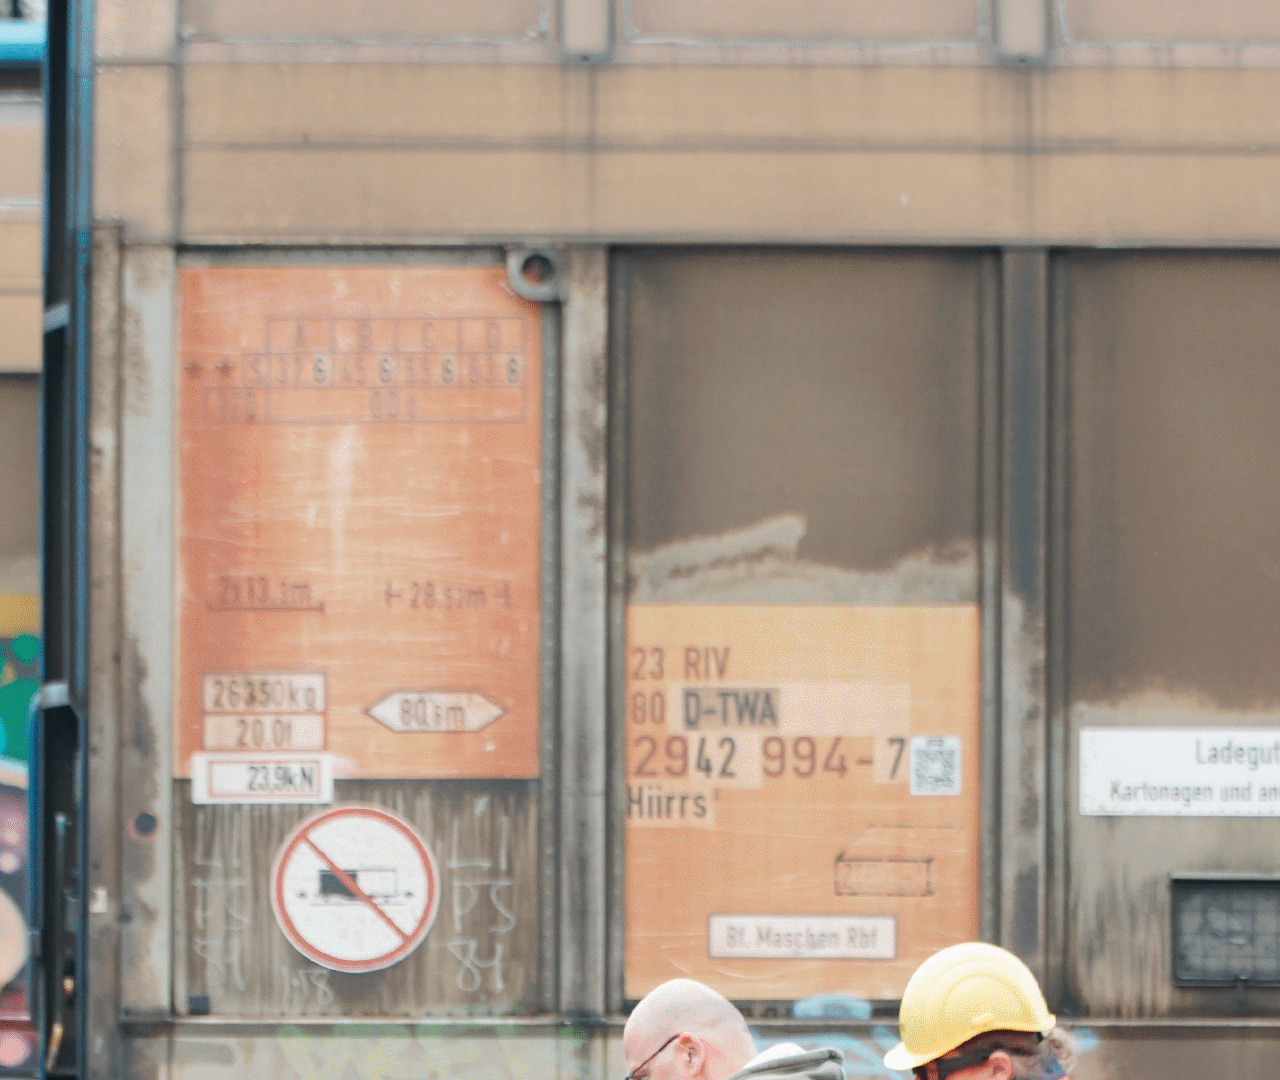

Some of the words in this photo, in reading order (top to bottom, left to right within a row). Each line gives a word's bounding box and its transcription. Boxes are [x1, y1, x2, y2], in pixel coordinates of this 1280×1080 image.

[632, 646, 665, 680] 23
[684, 646, 731, 681] RIV
[632, 691, 666, 724] 80
[684, 690, 779, 727] D-TWA
[626, 786, 709, 819] Hiirrs
[1109, 780, 1214, 807] Kartonagen
[1220, 780, 1253, 803] und
